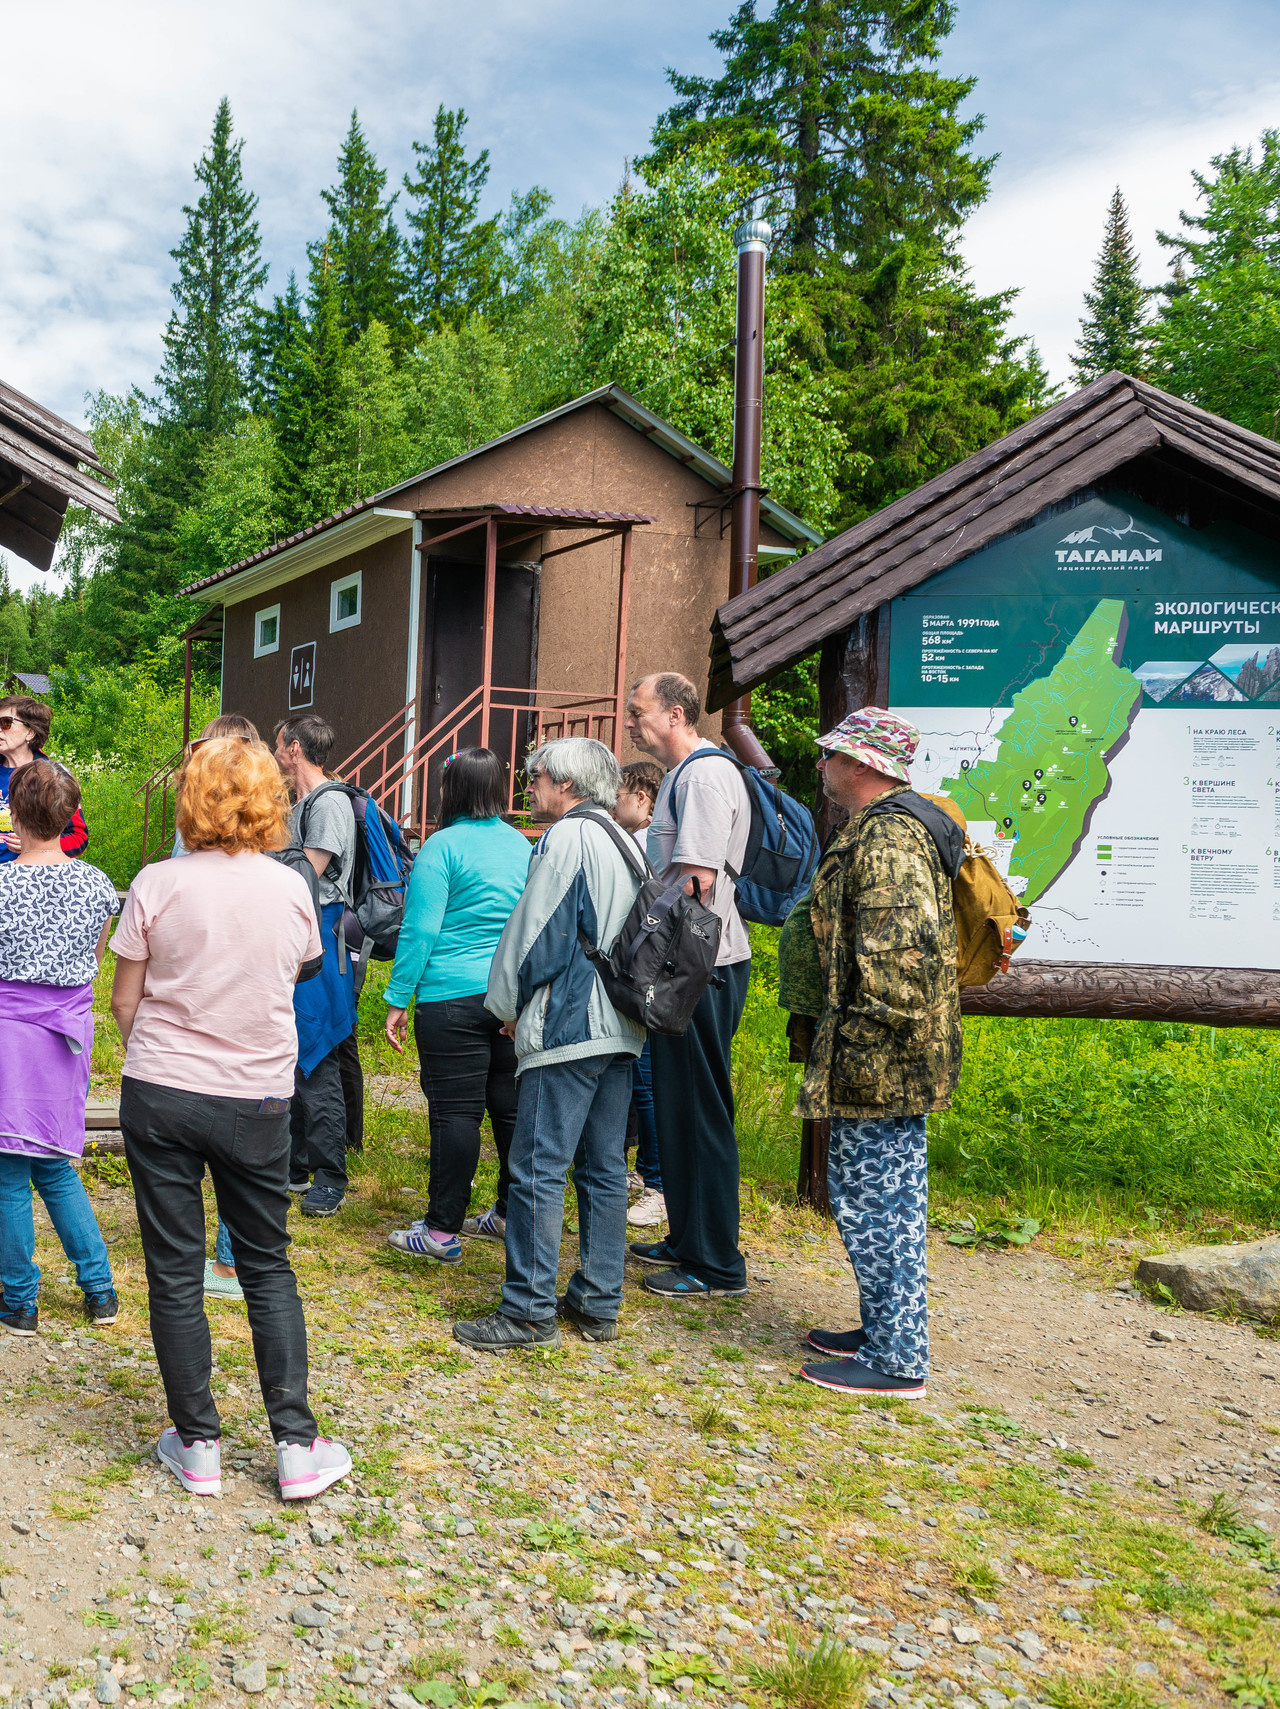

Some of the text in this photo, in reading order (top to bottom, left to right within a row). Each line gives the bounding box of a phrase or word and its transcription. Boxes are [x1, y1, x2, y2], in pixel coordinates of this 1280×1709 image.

[1055, 549, 1162, 562] ТАГАНАЙ
[922, 619, 929, 628] 5
[957, 618, 980, 628] 1991
[1154, 621, 1260, 634] МАРШРУТЫ
[922, 636, 941, 646] 568
[921, 654, 934, 662] 52
[921, 674, 948, 683] 10-15
[1187, 726, 1191, 734] 1
[1268, 726, 1274, 736] 2
[1183, 776, 1190, 786] 3
[1266, 778, 1273, 786] 4
[1182, 844, 1188, 854] 5
[1266, 846, 1272, 856] 6
